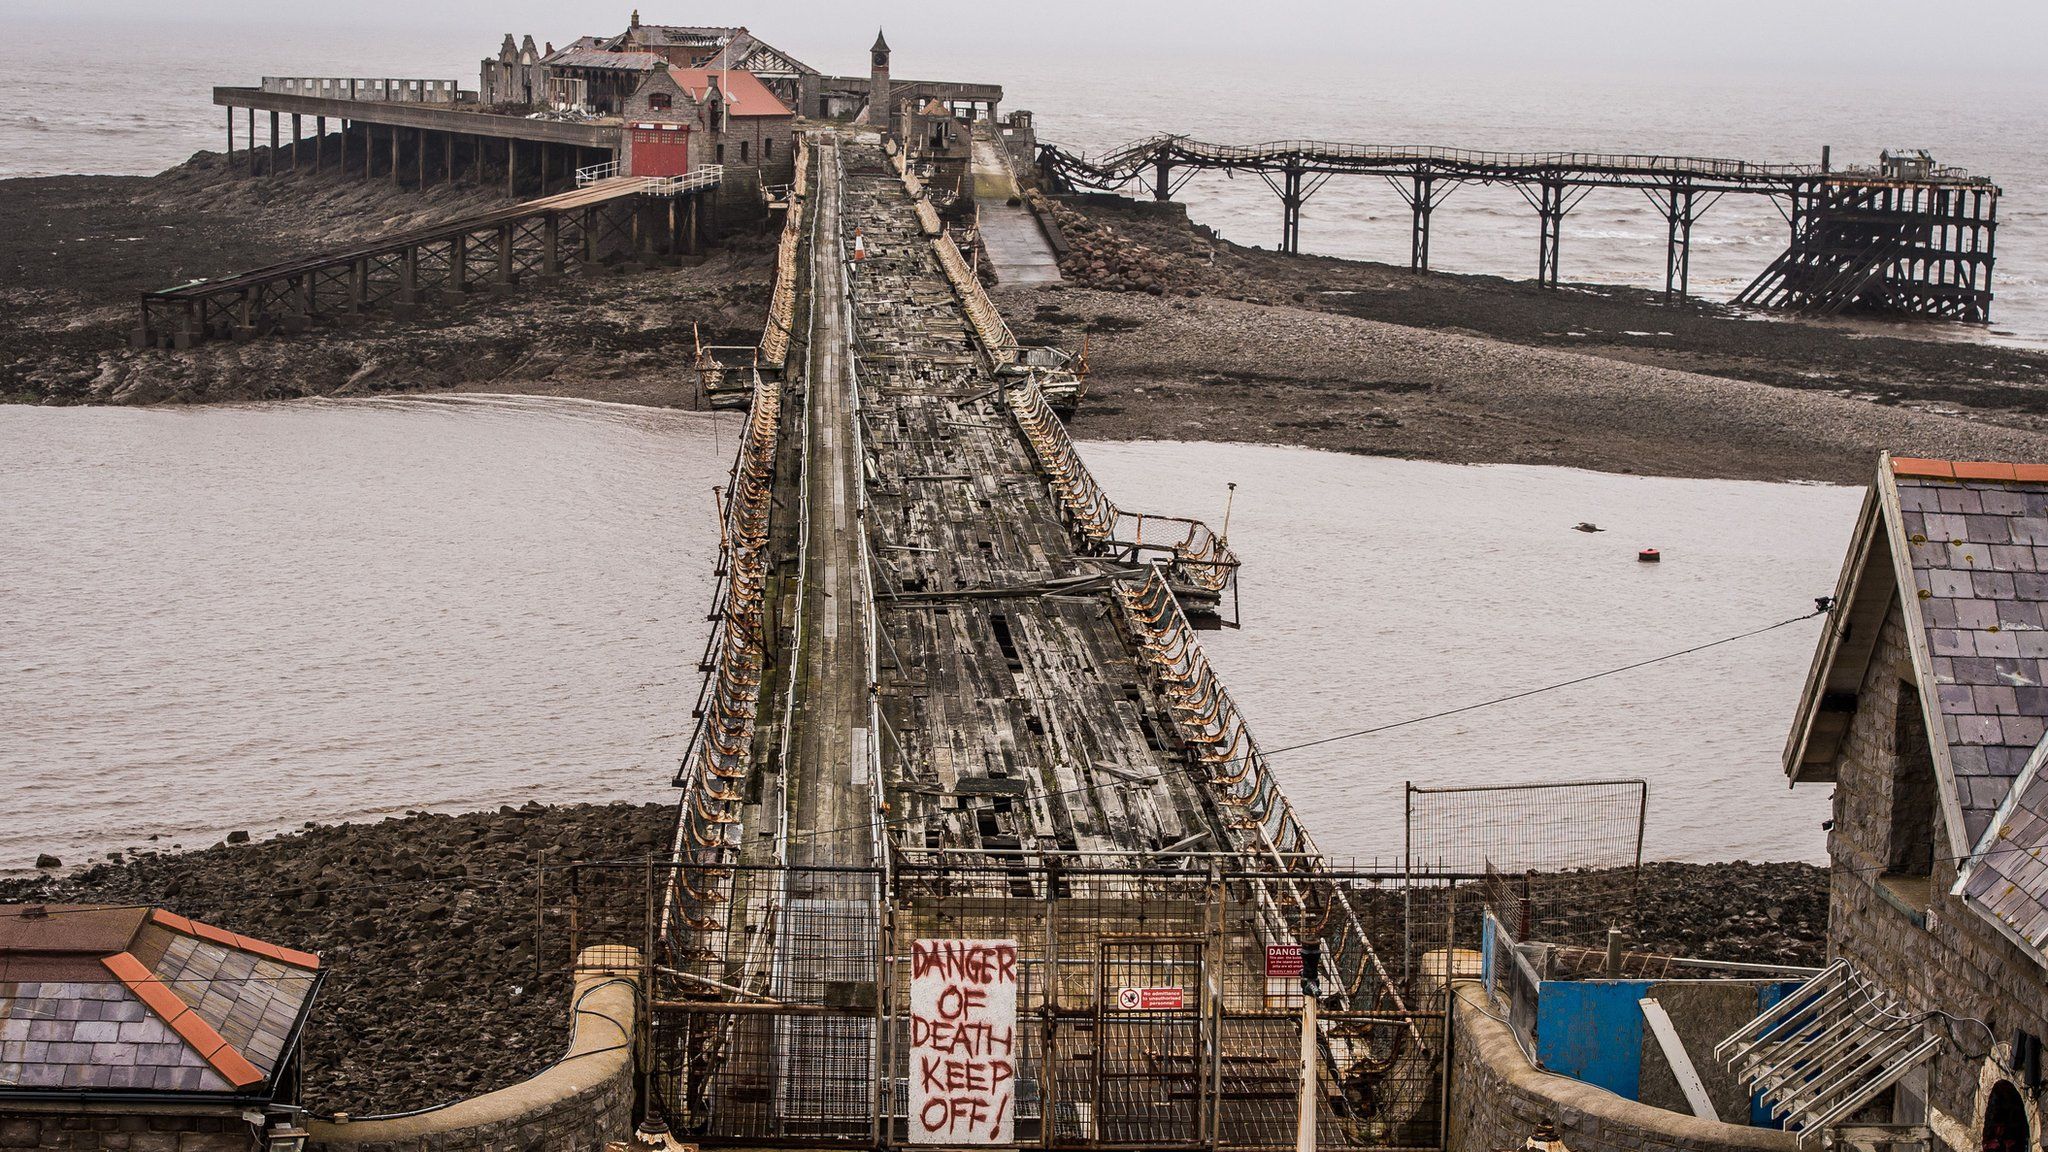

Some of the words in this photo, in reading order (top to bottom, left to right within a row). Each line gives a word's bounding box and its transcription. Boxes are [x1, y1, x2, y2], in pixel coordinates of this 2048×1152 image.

[912, 940, 1017, 984] DANGER
[1269, 948, 1302, 956] DANGE
[937, 984, 987, 1021] OF
[911, 1014, 1012, 1059] DEATH
[921, 1055, 1014, 1095] KEEP
[920, 1093, 1009, 1141] OFF!
